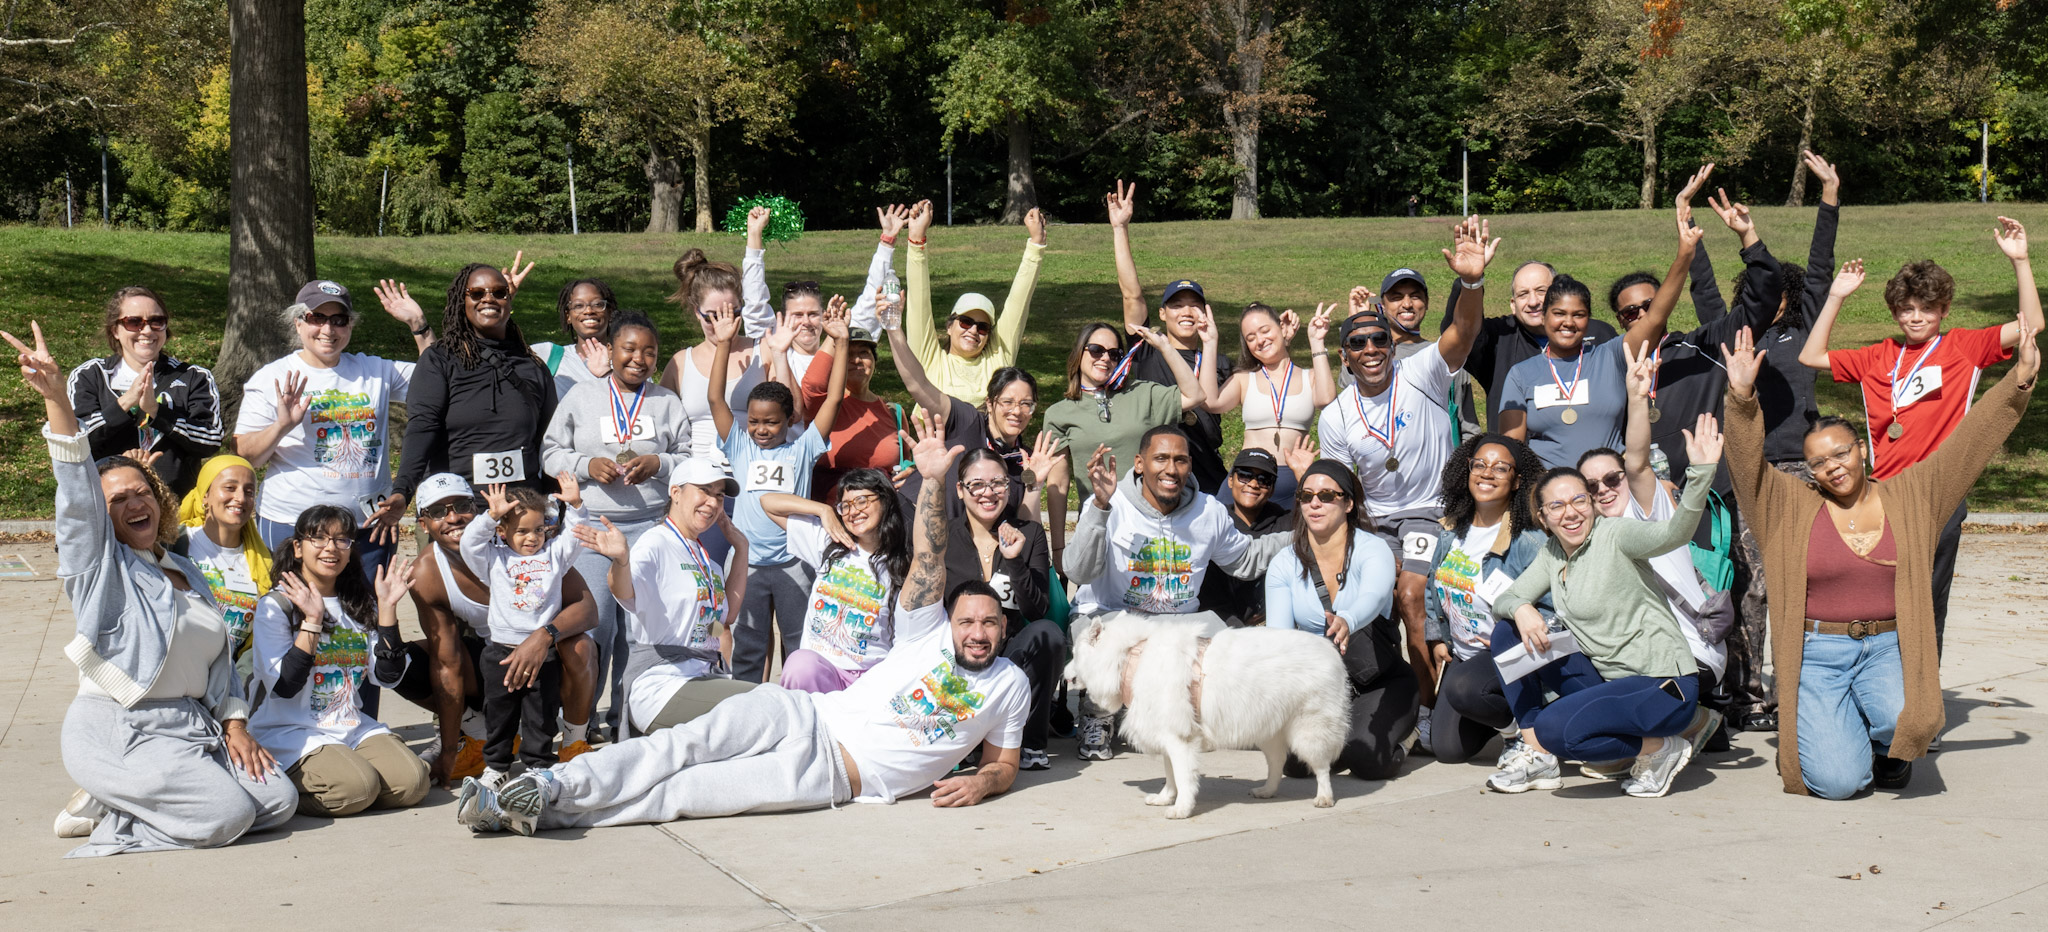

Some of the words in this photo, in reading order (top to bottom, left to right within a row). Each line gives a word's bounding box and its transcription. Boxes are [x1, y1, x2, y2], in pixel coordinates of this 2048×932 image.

[1911, 375, 1925, 396] 3
[310, 391, 371, 410] ROOTED
[310, 409, 333, 425] EAST
[334, 409, 352, 421] NEW
[353, 407, 377, 421] YORK
[485, 456, 515, 479] 38
[754, 464, 786, 486] 34
[1128, 559, 1151, 573] EAST
[822, 567, 886, 600] ROOTED
[1455, 576, 1476, 595] YORK
[214, 588, 233, 603] NEW
[234, 594, 258, 612] YORK
[816, 581, 837, 598] EAST
[836, 586, 856, 605] NEW
[856, 594, 883, 616] YORK
[315, 652, 332, 666] AST
[333, 653, 352, 666] NEW
[920, 671, 942, 697] EAST
